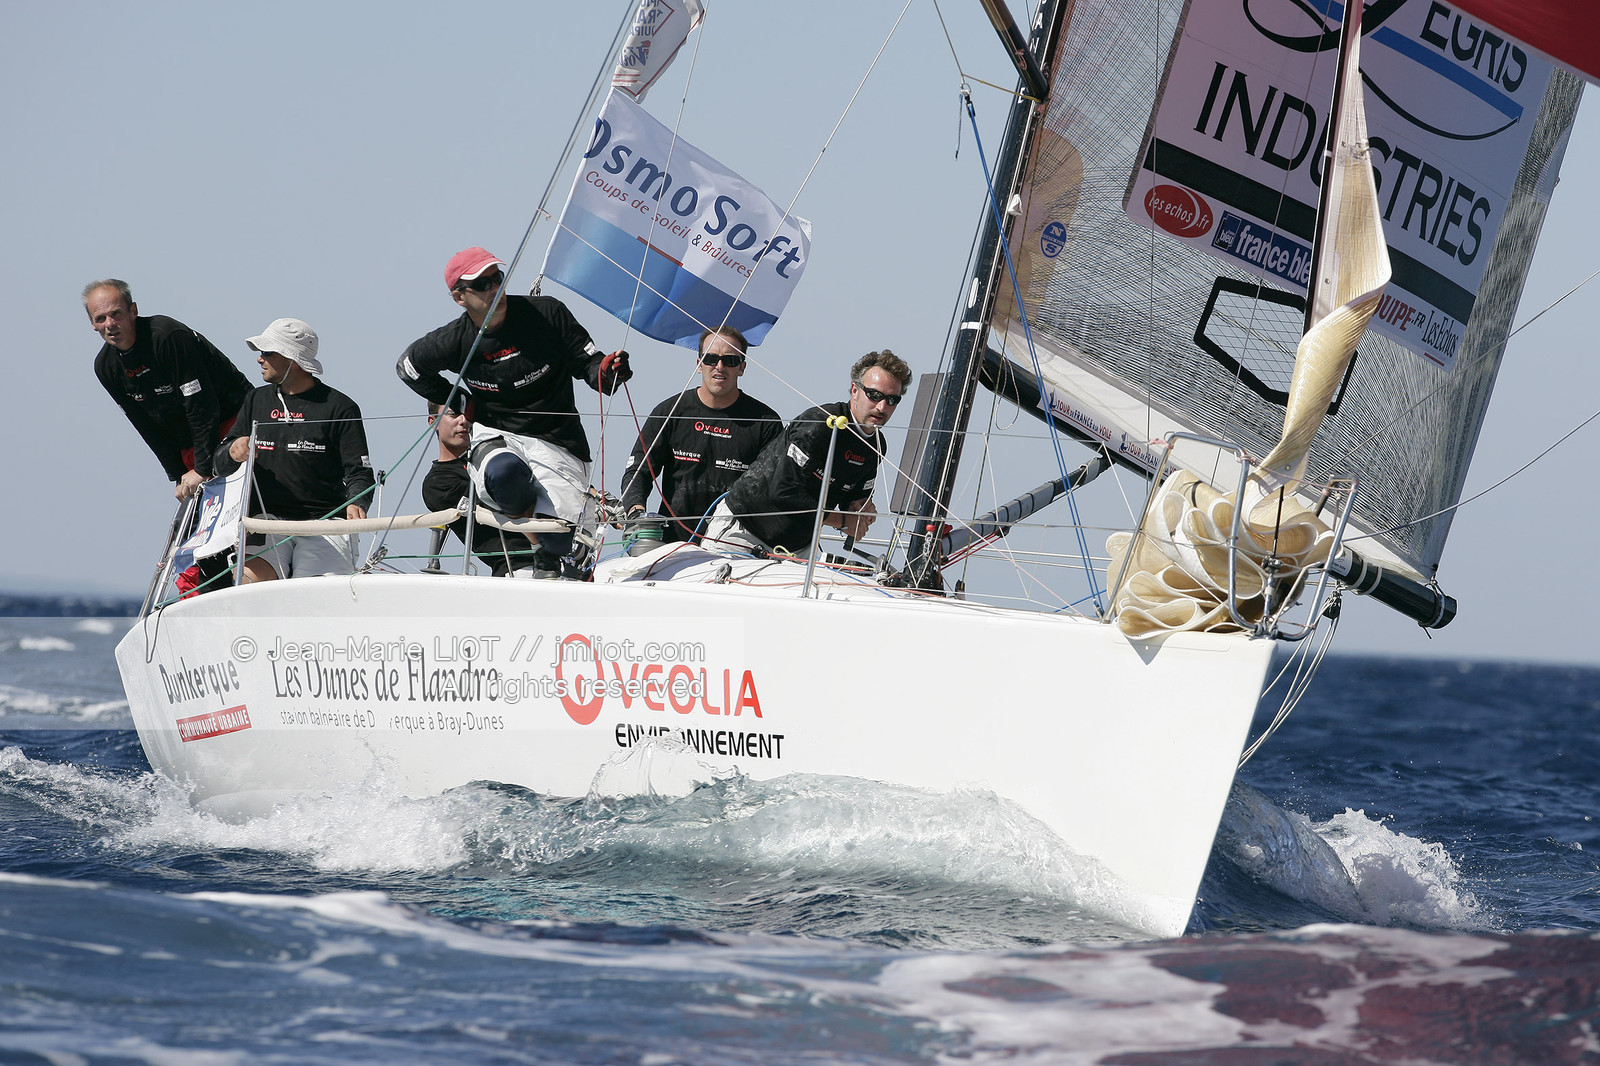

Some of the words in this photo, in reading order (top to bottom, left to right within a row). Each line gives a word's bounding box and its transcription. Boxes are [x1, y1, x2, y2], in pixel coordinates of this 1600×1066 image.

[586, 171, 629, 202] Coups
[631, 199, 650, 214] de
[651, 213, 691, 239] soleil
[691, 234, 702, 246] &
[701, 240, 753, 278] Brûlures
[703, 195, 801, 279] Soft
[1235, 225, 1290, 273] france
[159, 656, 240, 705] Dunkerque
[267, 650, 302, 698] Les
[302, 650, 368, 701] Dunes
[375, 648, 400, 702] de
[612, 661, 763, 718] VEOLIA
[178, 711, 218, 738] COMMUNAUTÉ
[218, 709, 249, 730] URBAINE
[354, 709, 366, 728] de
[428, 711, 435, 730] à
[437, 711, 504, 735] Bray-Dunes
